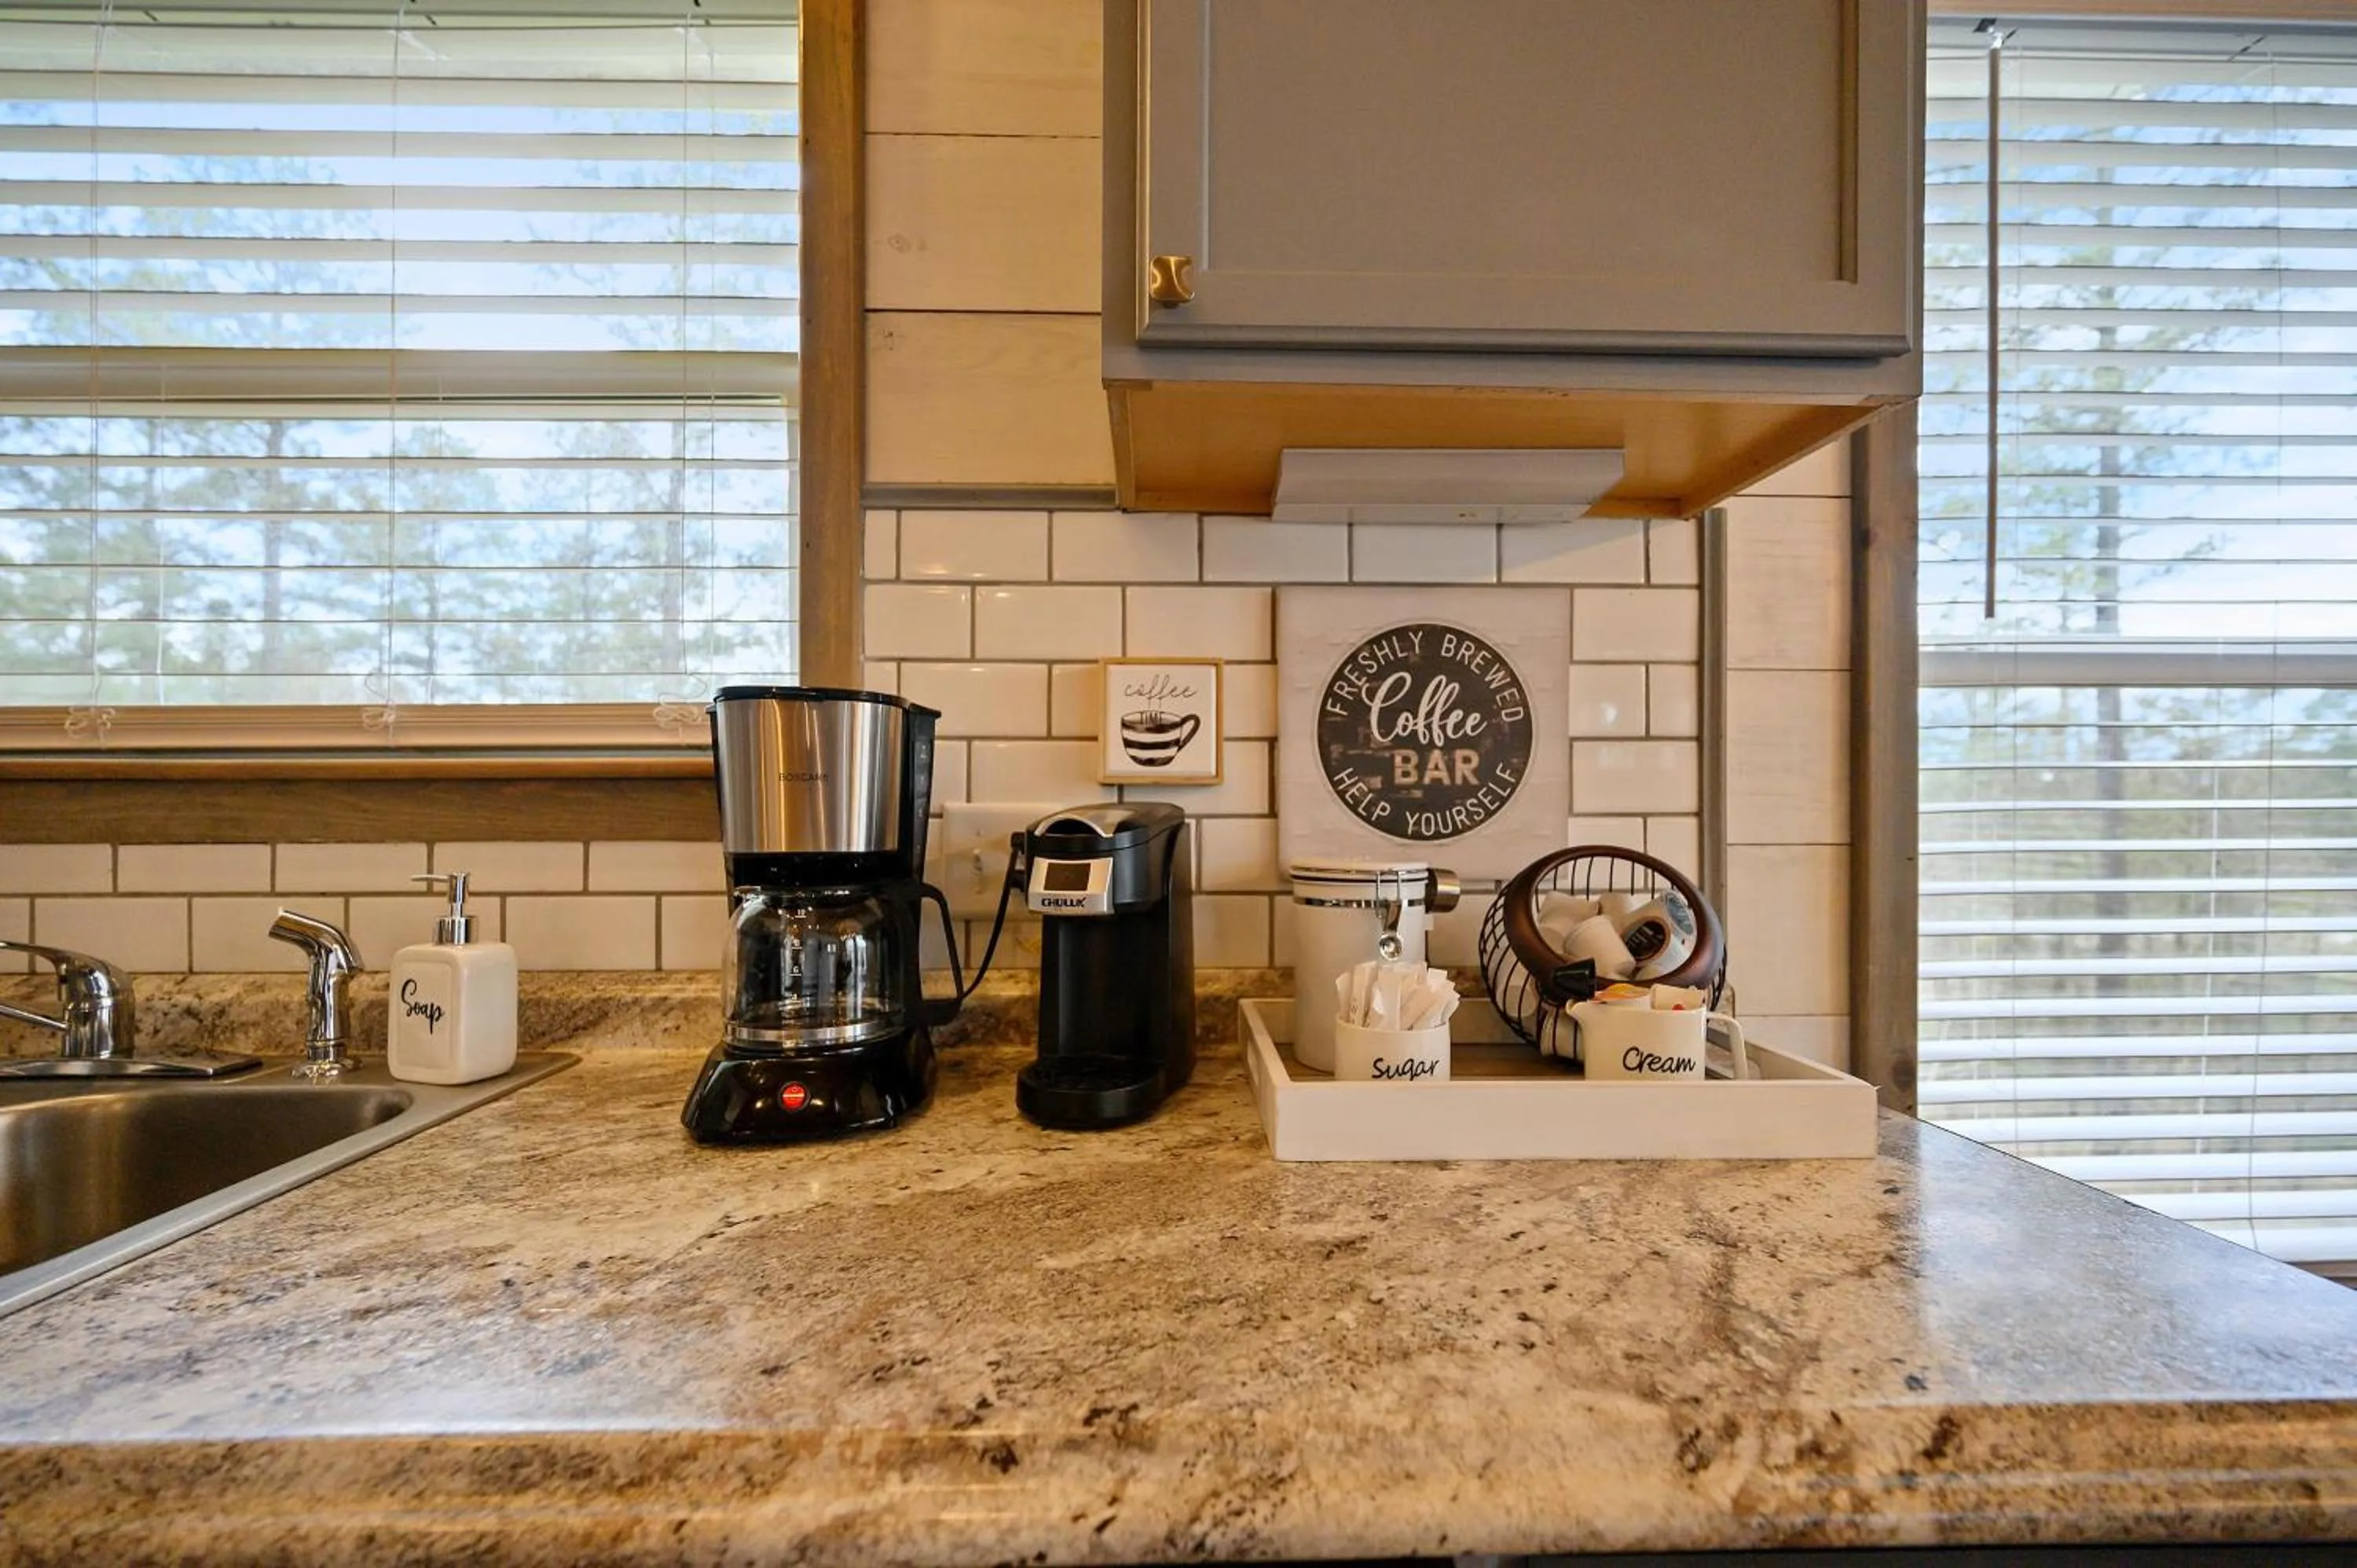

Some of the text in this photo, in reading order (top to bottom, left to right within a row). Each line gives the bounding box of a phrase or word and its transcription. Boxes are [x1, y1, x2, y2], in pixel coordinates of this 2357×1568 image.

[1124, 674, 1197, 701] coffee
[1326, 631, 1524, 722] FRESHLY BREWED
[1362, 672, 1487, 746] Coffee
[1392, 749, 1480, 786] BAR
[1332, 761, 1516, 837] HELP YOURSELF
[401, 978, 445, 1034] Soap
[1371, 1057, 1439, 1082] Sugar
[1622, 1046, 1695, 1074] Cream
